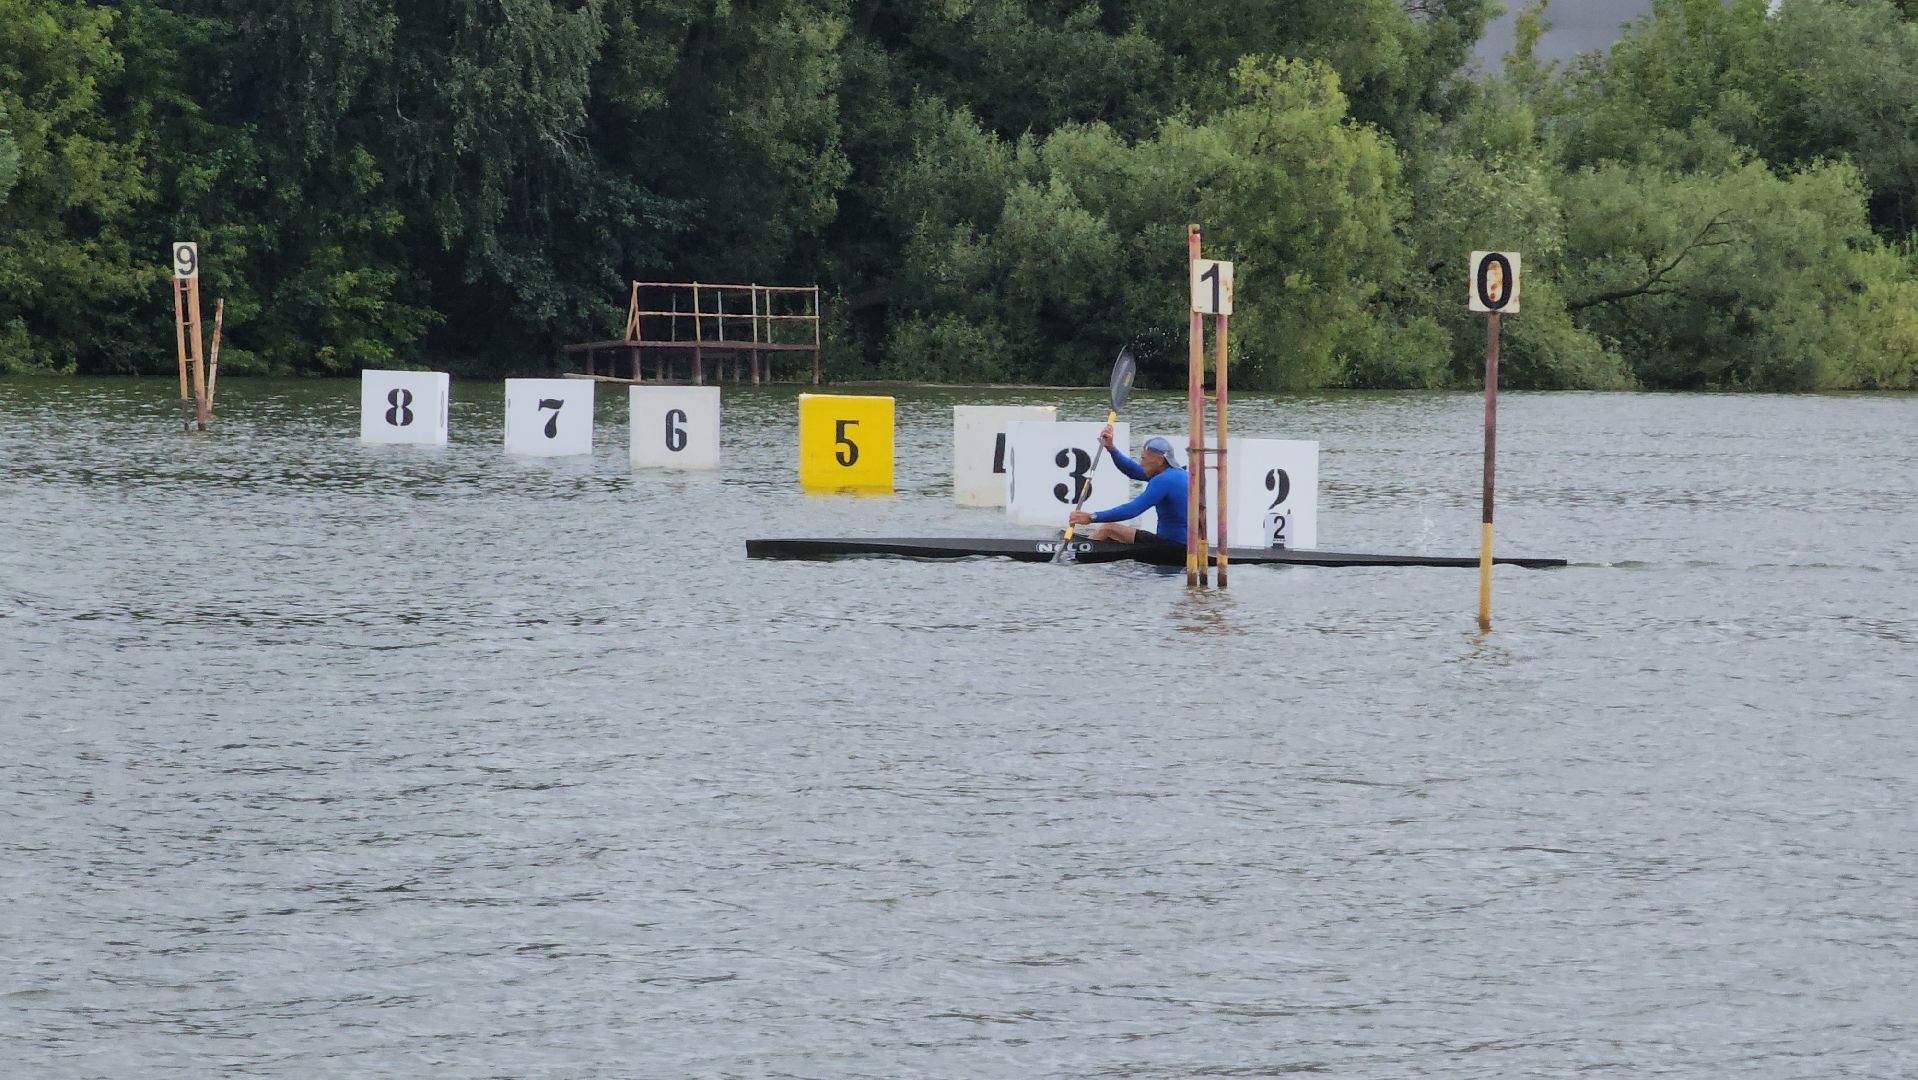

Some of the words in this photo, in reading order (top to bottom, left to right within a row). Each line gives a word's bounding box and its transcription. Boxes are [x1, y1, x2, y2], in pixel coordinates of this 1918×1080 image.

[177, 245, 195, 275] 9
[1477, 252, 1513, 310] 0
[1201, 264, 1219, 313] 1
[386, 389, 413, 426] 8
[538, 399, 564, 438] 7
[666, 409, 687, 451] 6
[836, 420, 859, 467] 5
[1054, 448, 1092, 504] 3
[1273, 515, 1286, 539] 2
